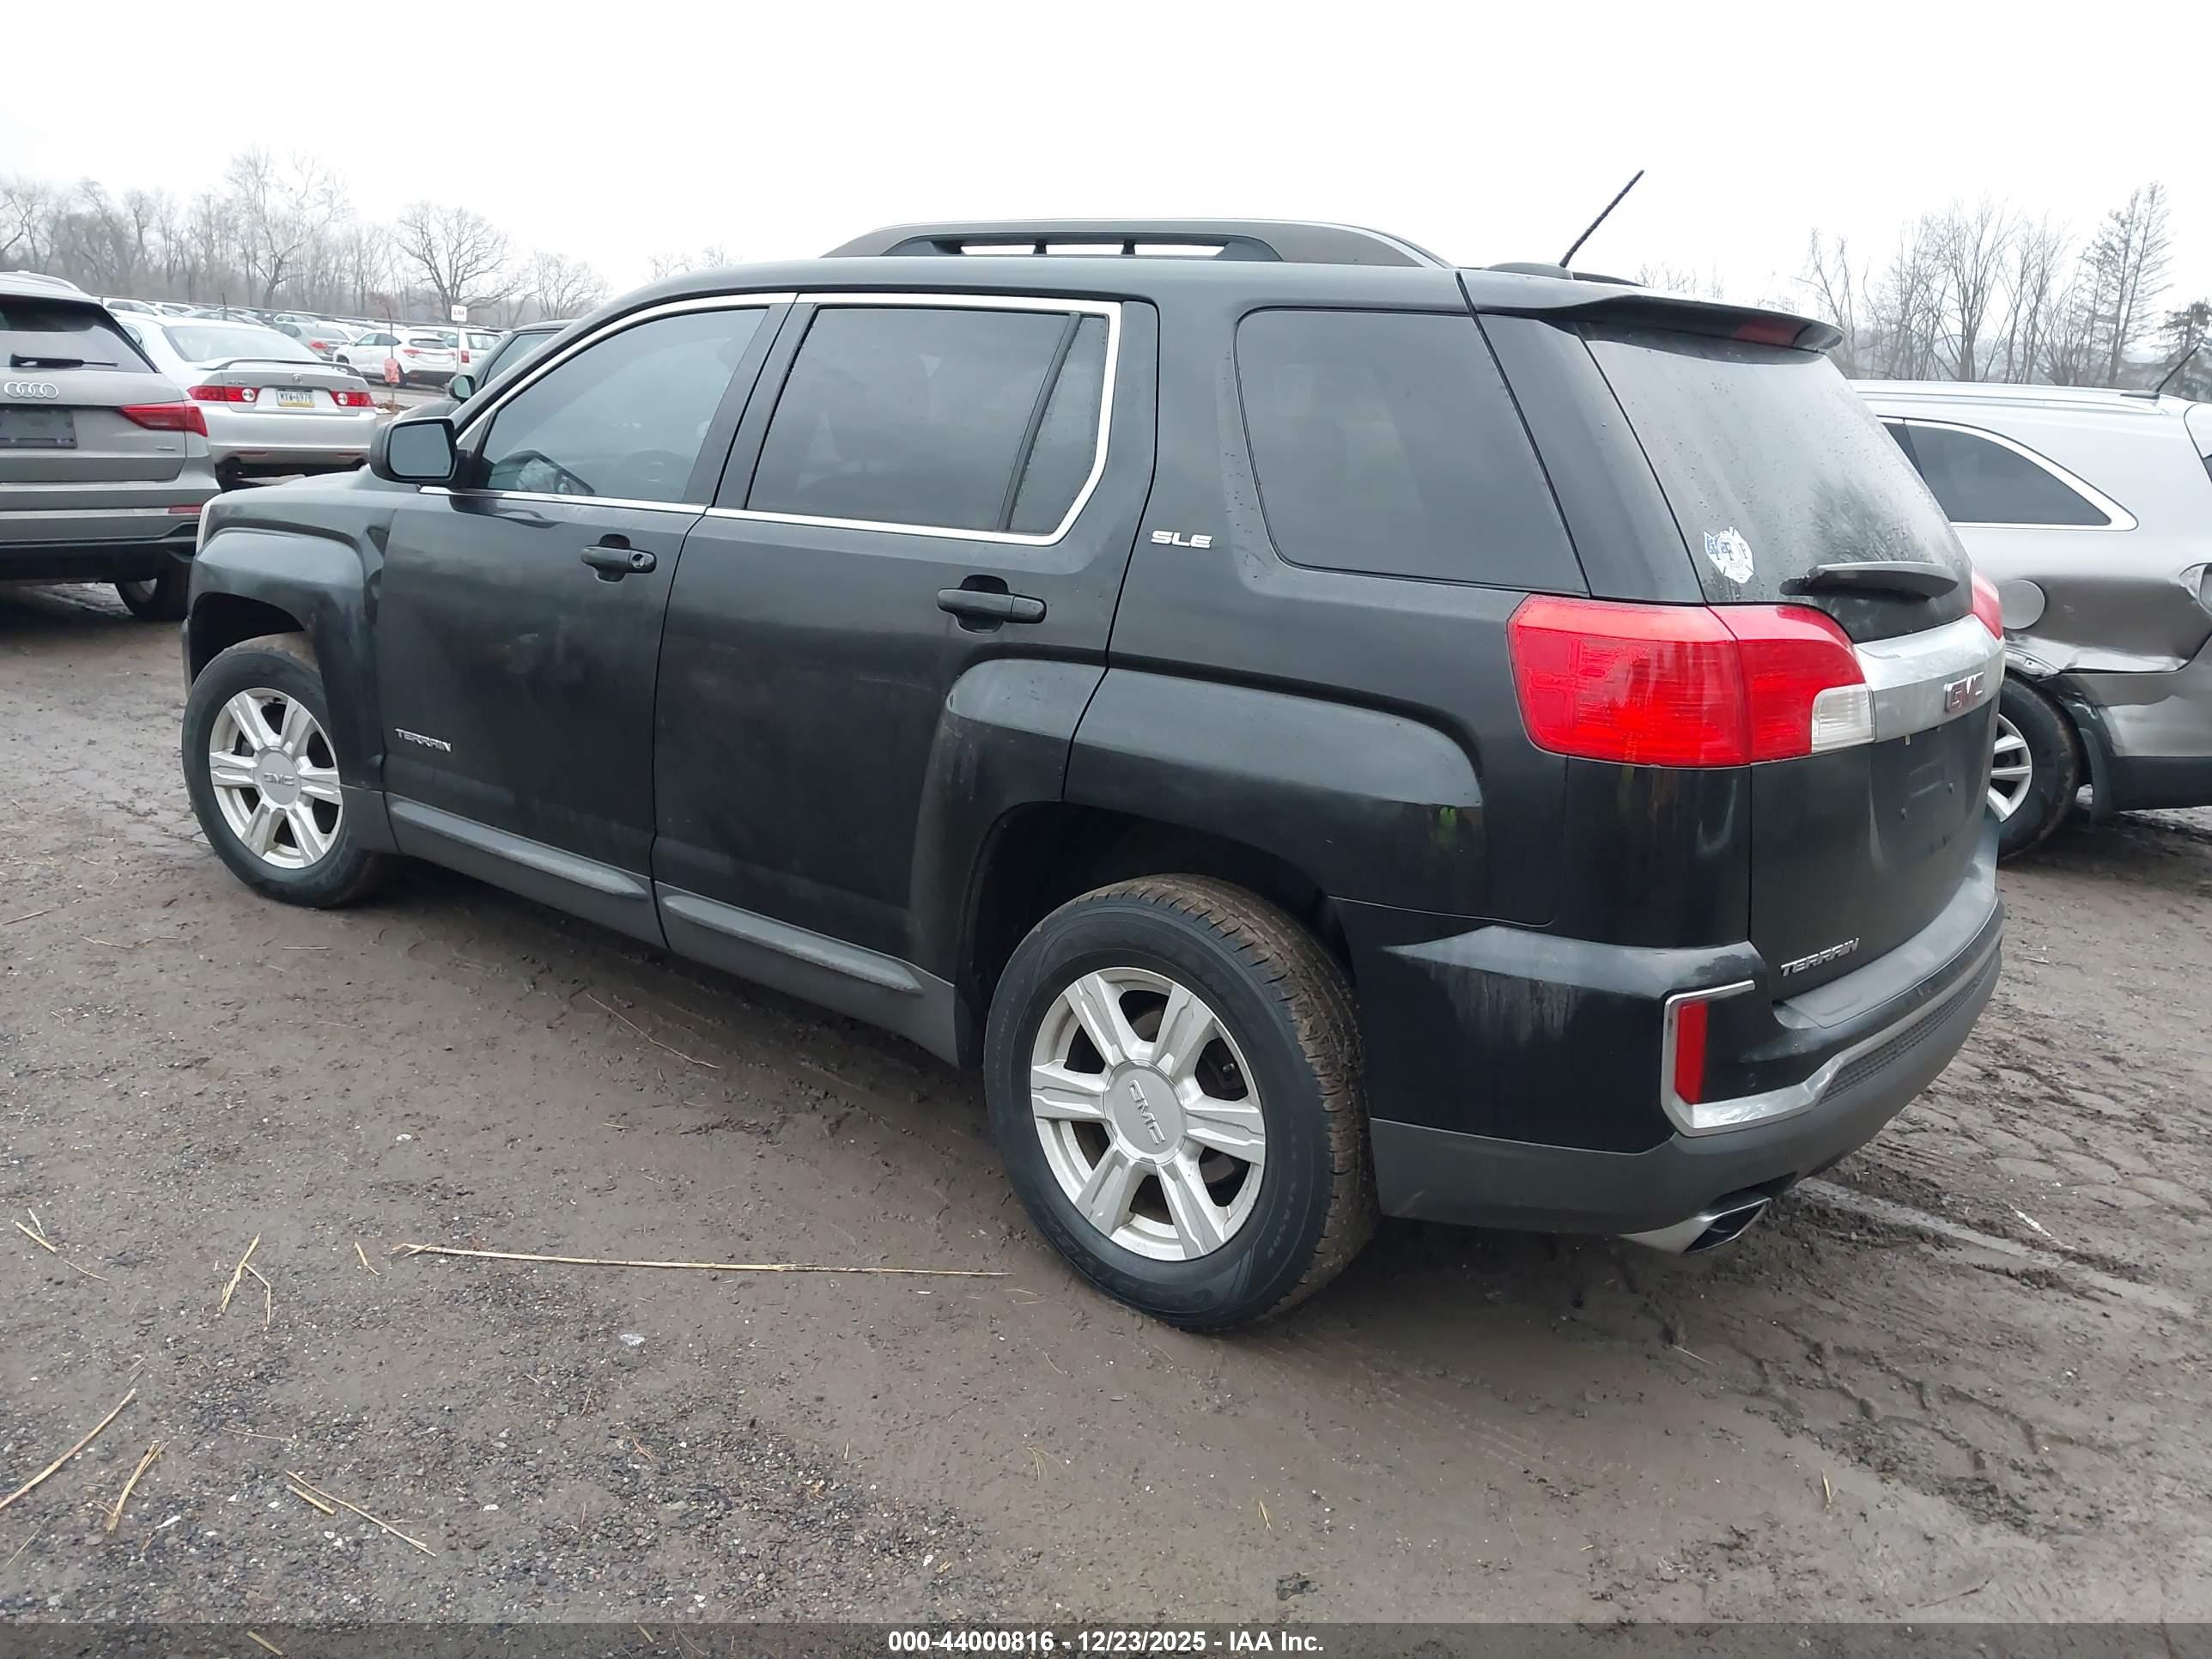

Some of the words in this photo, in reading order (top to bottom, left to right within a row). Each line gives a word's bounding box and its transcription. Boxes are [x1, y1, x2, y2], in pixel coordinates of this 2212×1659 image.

[1151, 530, 1212, 549] SLE
[1945, 672, 1984, 712] GMC
[394, 728, 452, 752] TERRAIN
[264, 772, 295, 787] GMC
[1780, 937, 1860, 977] TERRAIN
[1128, 1079, 1166, 1145] GMC
